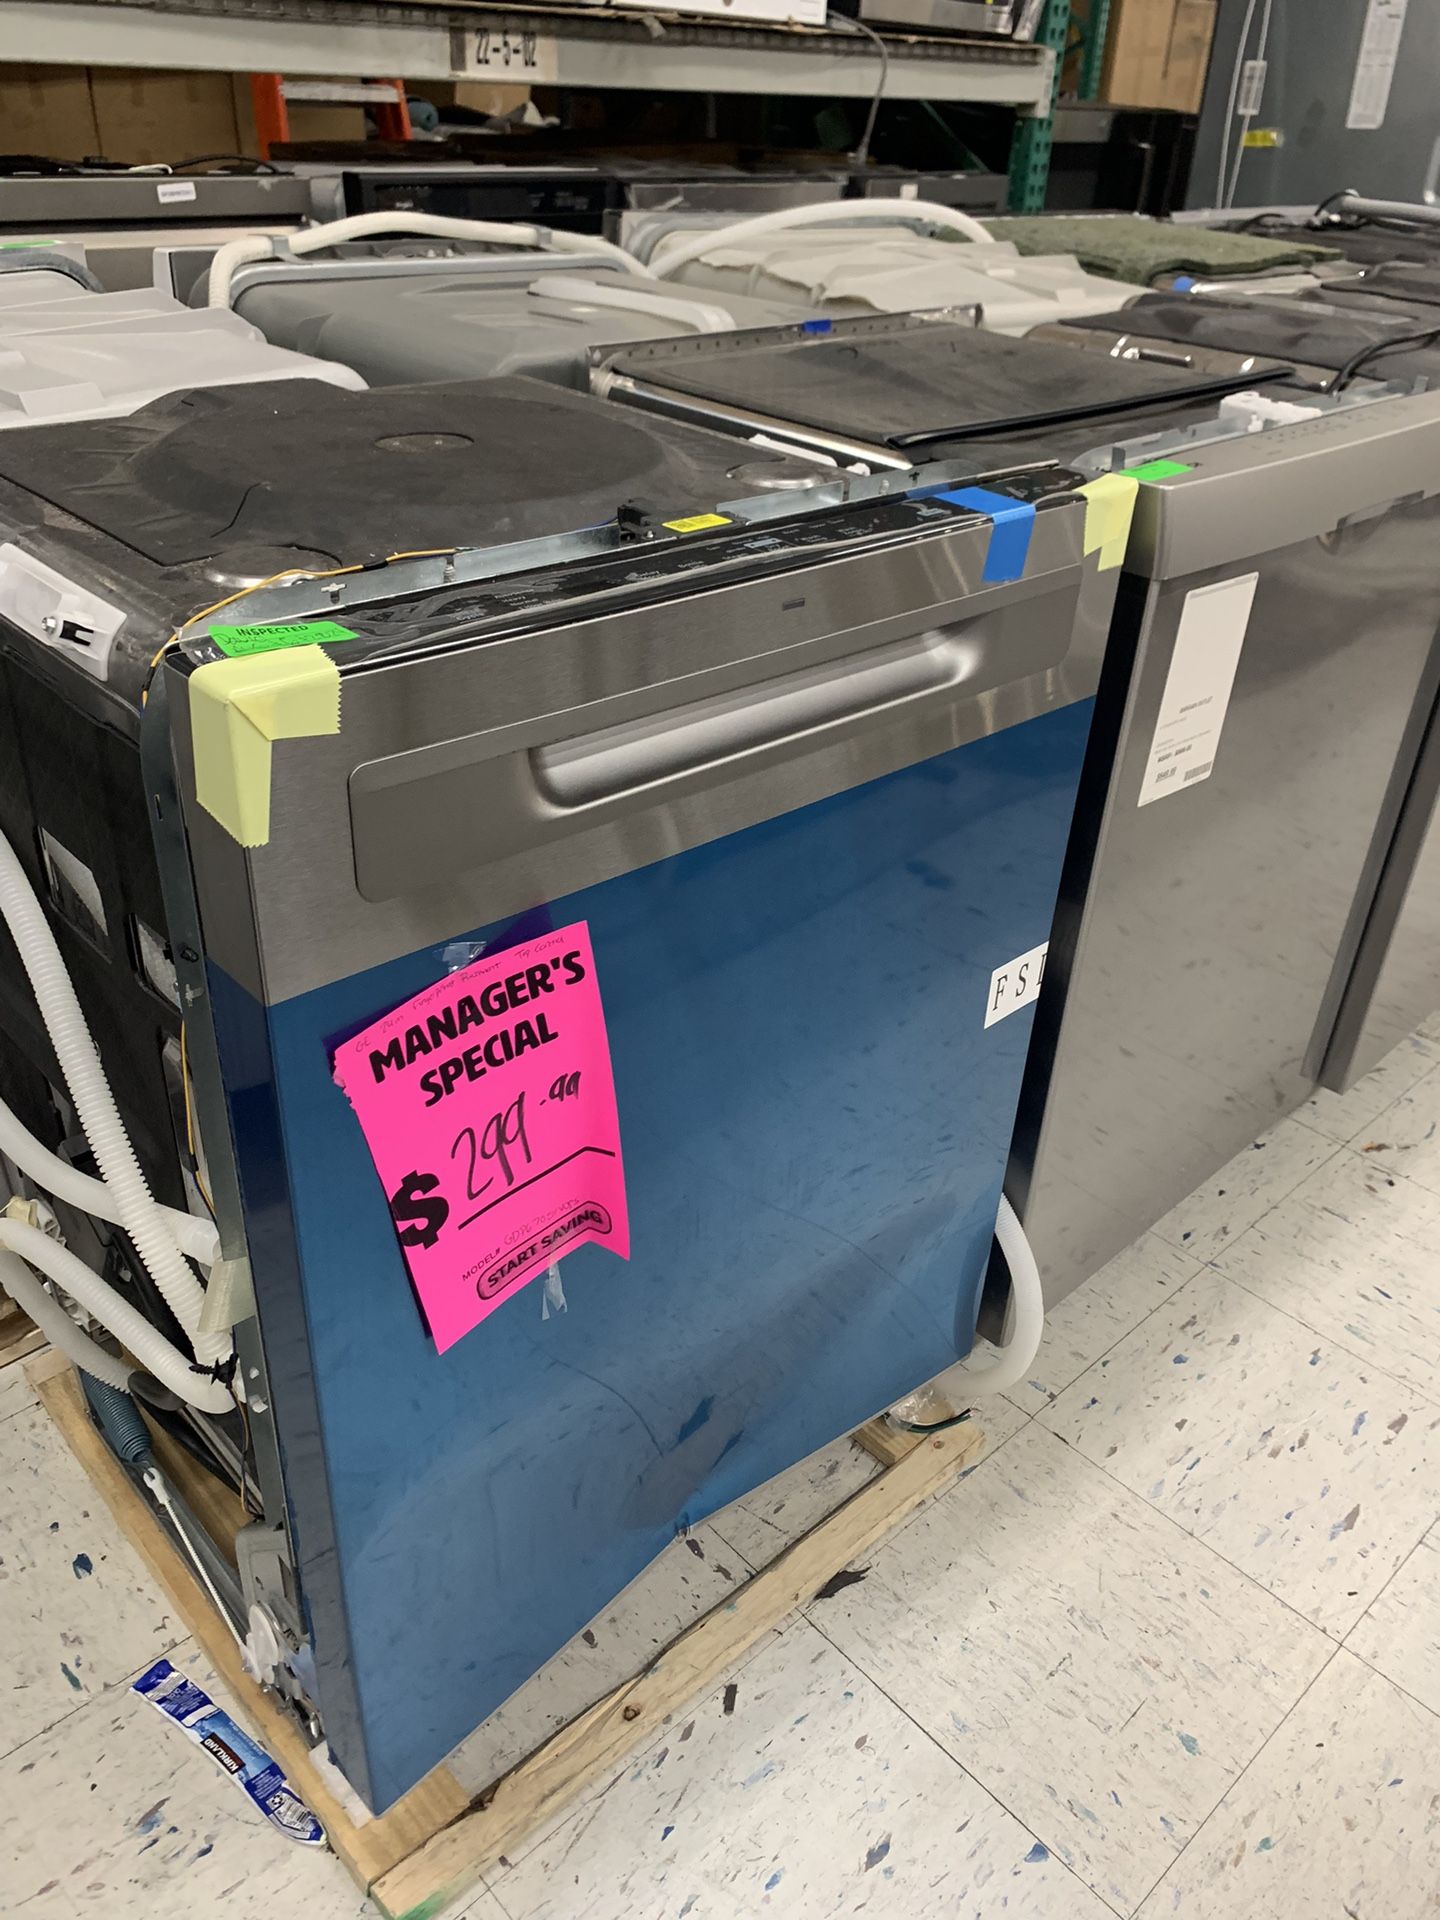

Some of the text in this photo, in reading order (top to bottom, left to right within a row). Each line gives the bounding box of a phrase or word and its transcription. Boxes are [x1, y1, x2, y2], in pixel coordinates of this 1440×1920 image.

[235, 624, 310, 637] INSPECTED
[369, 950, 586, 1083] MANAGER'S
[420, 1012, 559, 1108] SPECIAL
[461, 1247, 501, 1282] MODEL#
[487, 1209, 604, 1288] START SAVING
[204, 1738, 239, 1771] KIRKLAND
